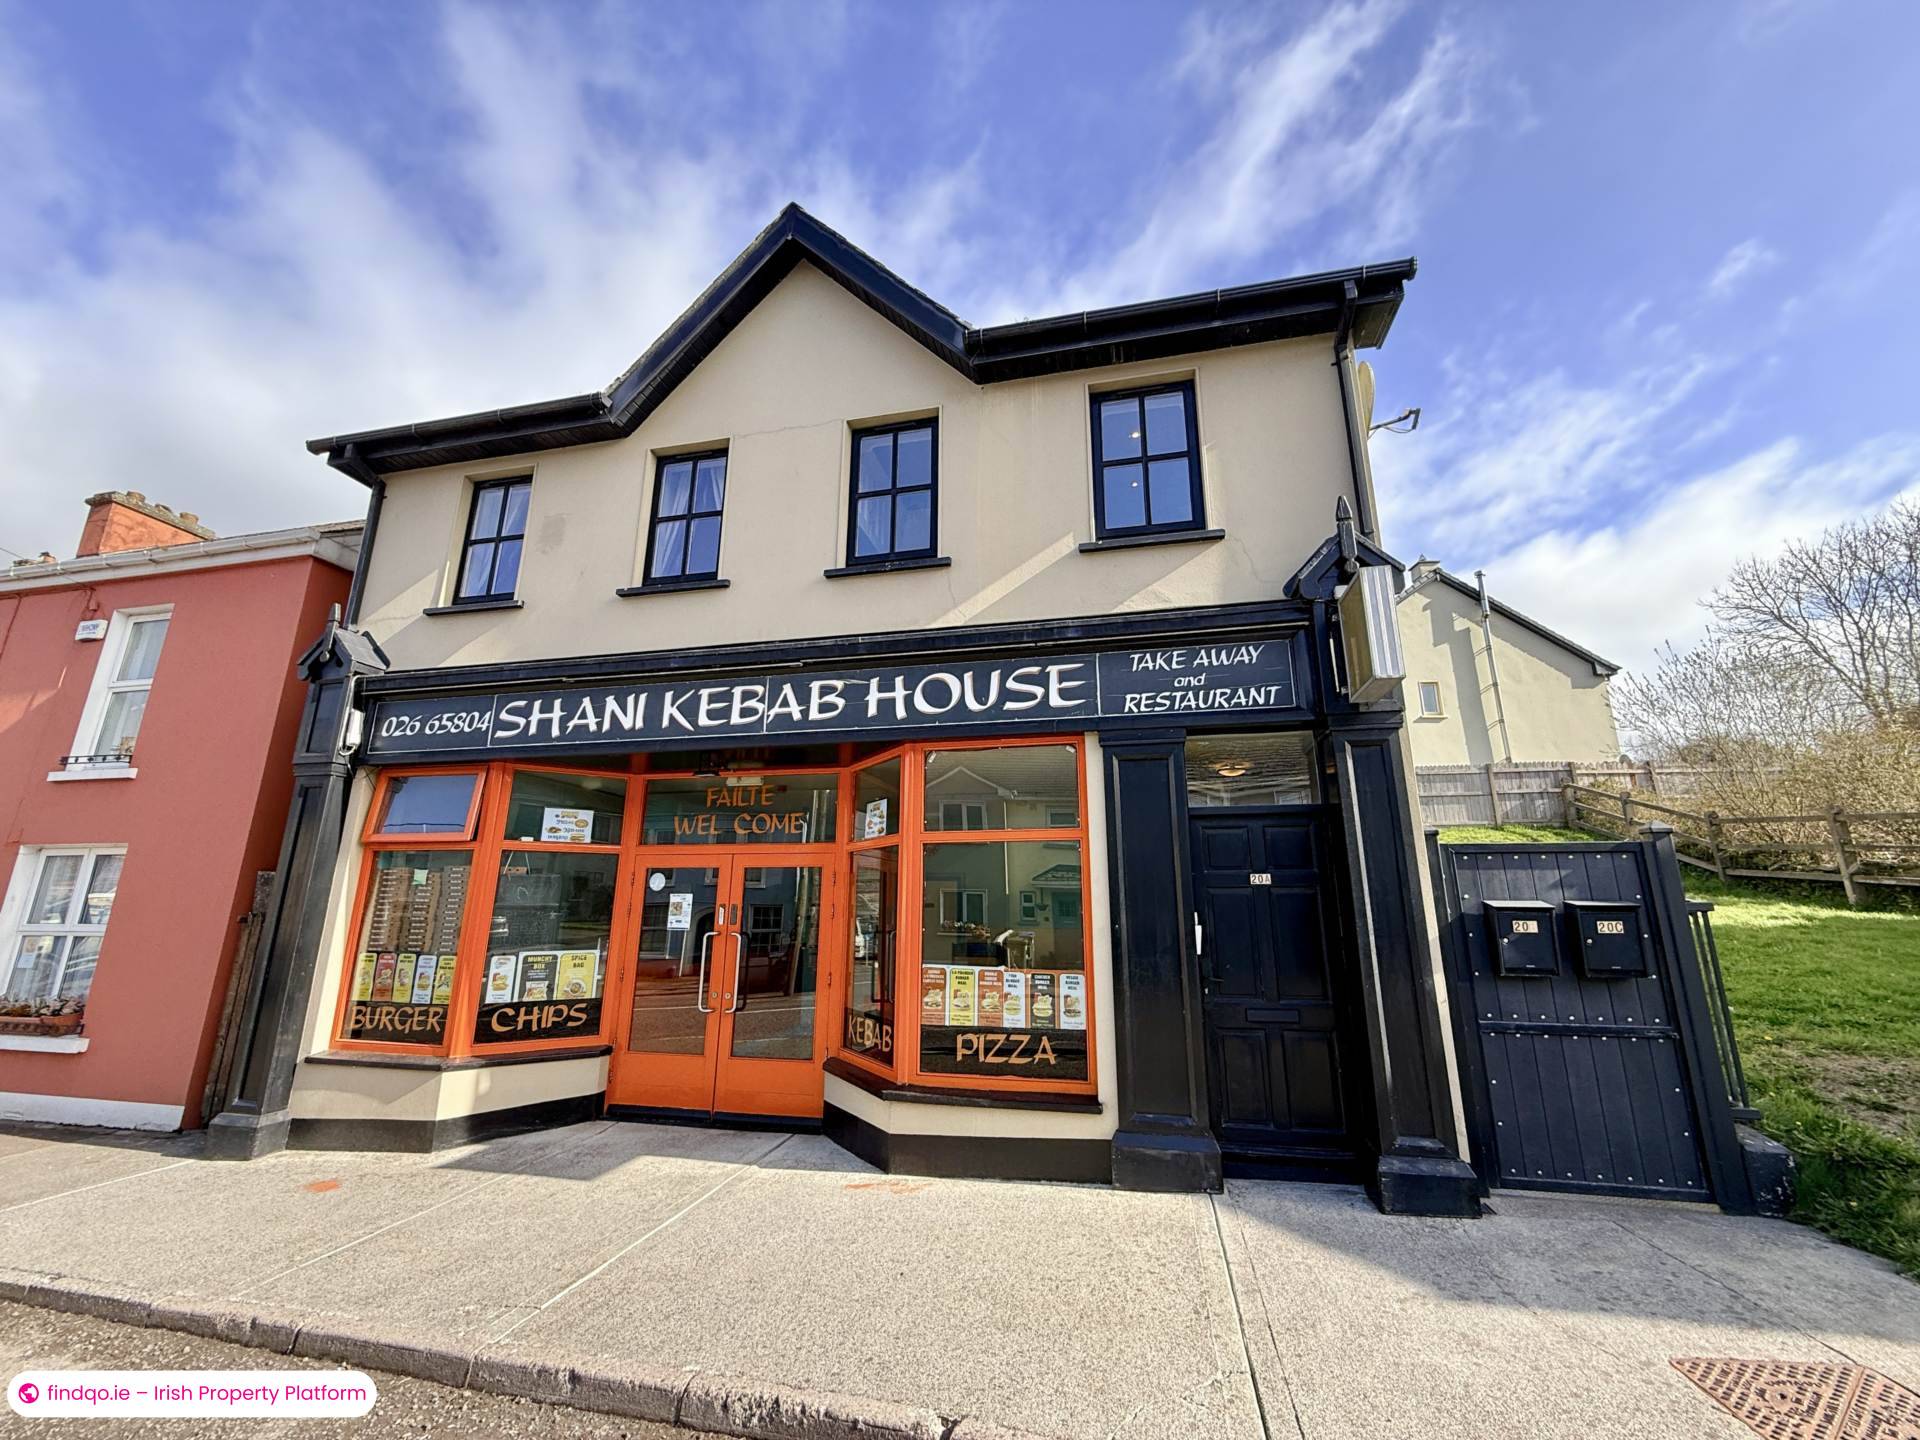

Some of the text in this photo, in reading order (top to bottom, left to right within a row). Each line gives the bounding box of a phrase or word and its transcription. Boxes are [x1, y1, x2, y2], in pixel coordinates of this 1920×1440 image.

[1129, 644, 1265, 672] TAKE AWAY
[1173, 673, 1206, 687] and
[494, 663, 1089, 739] SHANI KEBAB HOUSE
[1124, 686, 1282, 714] RESTAURANT
[381, 710, 491, 738] 026 65804
[705, 784, 776, 808] FAILTE
[1598, 921, 1624, 933] 20C
[351, 1005, 444, 1034] BURGER
[492, 1002, 589, 1032] CHIPS
[848, 1015, 893, 1052] KEBAB
[956, 1032, 1058, 1065] PIZZA
